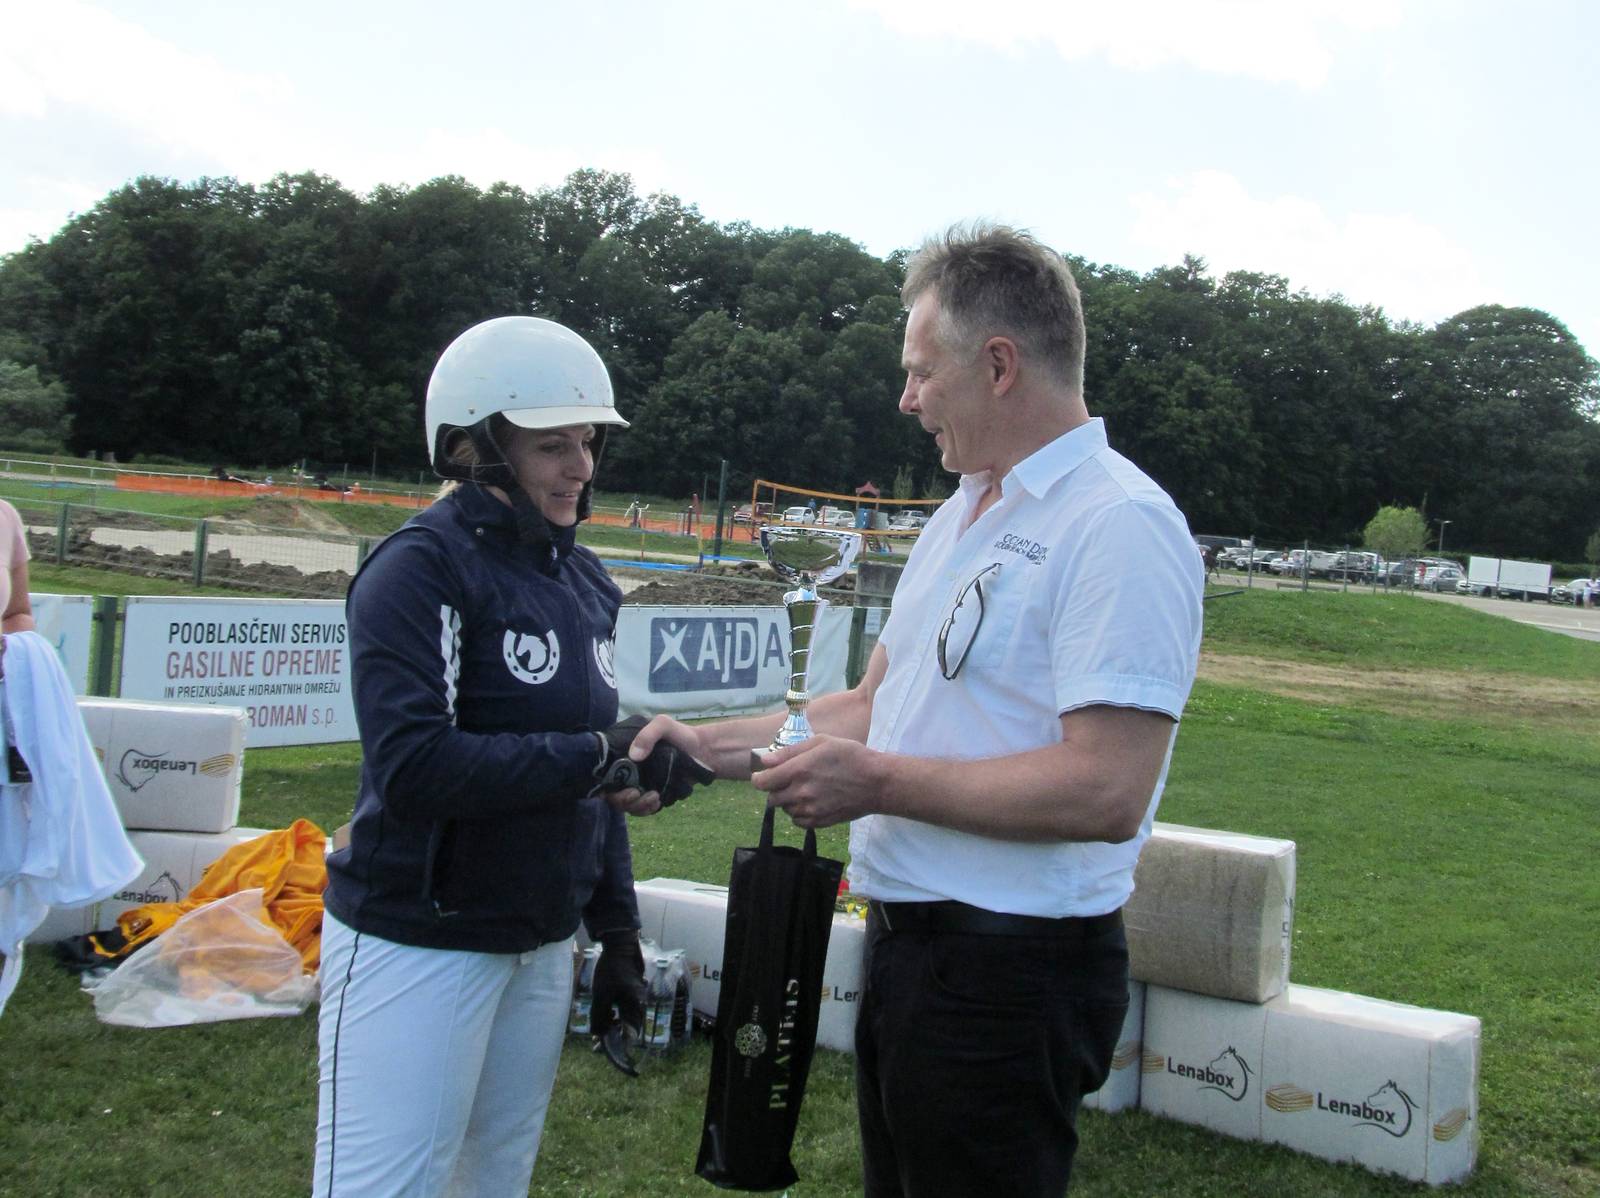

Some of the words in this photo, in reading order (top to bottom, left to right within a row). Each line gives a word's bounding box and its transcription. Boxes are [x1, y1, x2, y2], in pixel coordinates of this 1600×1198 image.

[168, 618, 286, 645] POOBLASČENI
[291, 623, 346, 644] SERVIS
[166, 650, 256, 680] GASILNE
[262, 649, 342, 677] OPREME
[164, 687, 174, 699] IN
[177, 682, 246, 698] PREIZKUŠANJE
[248, 683, 302, 696] HIDRANTNIH
[304, 680, 341, 694] OMREŽIJ
[312, 707, 338, 729] s.p.
[132, 758, 197, 776] Lenabox
[1167, 1056, 1235, 1090] Lenabox
[1316, 1091, 1396, 1126] Lenabox
